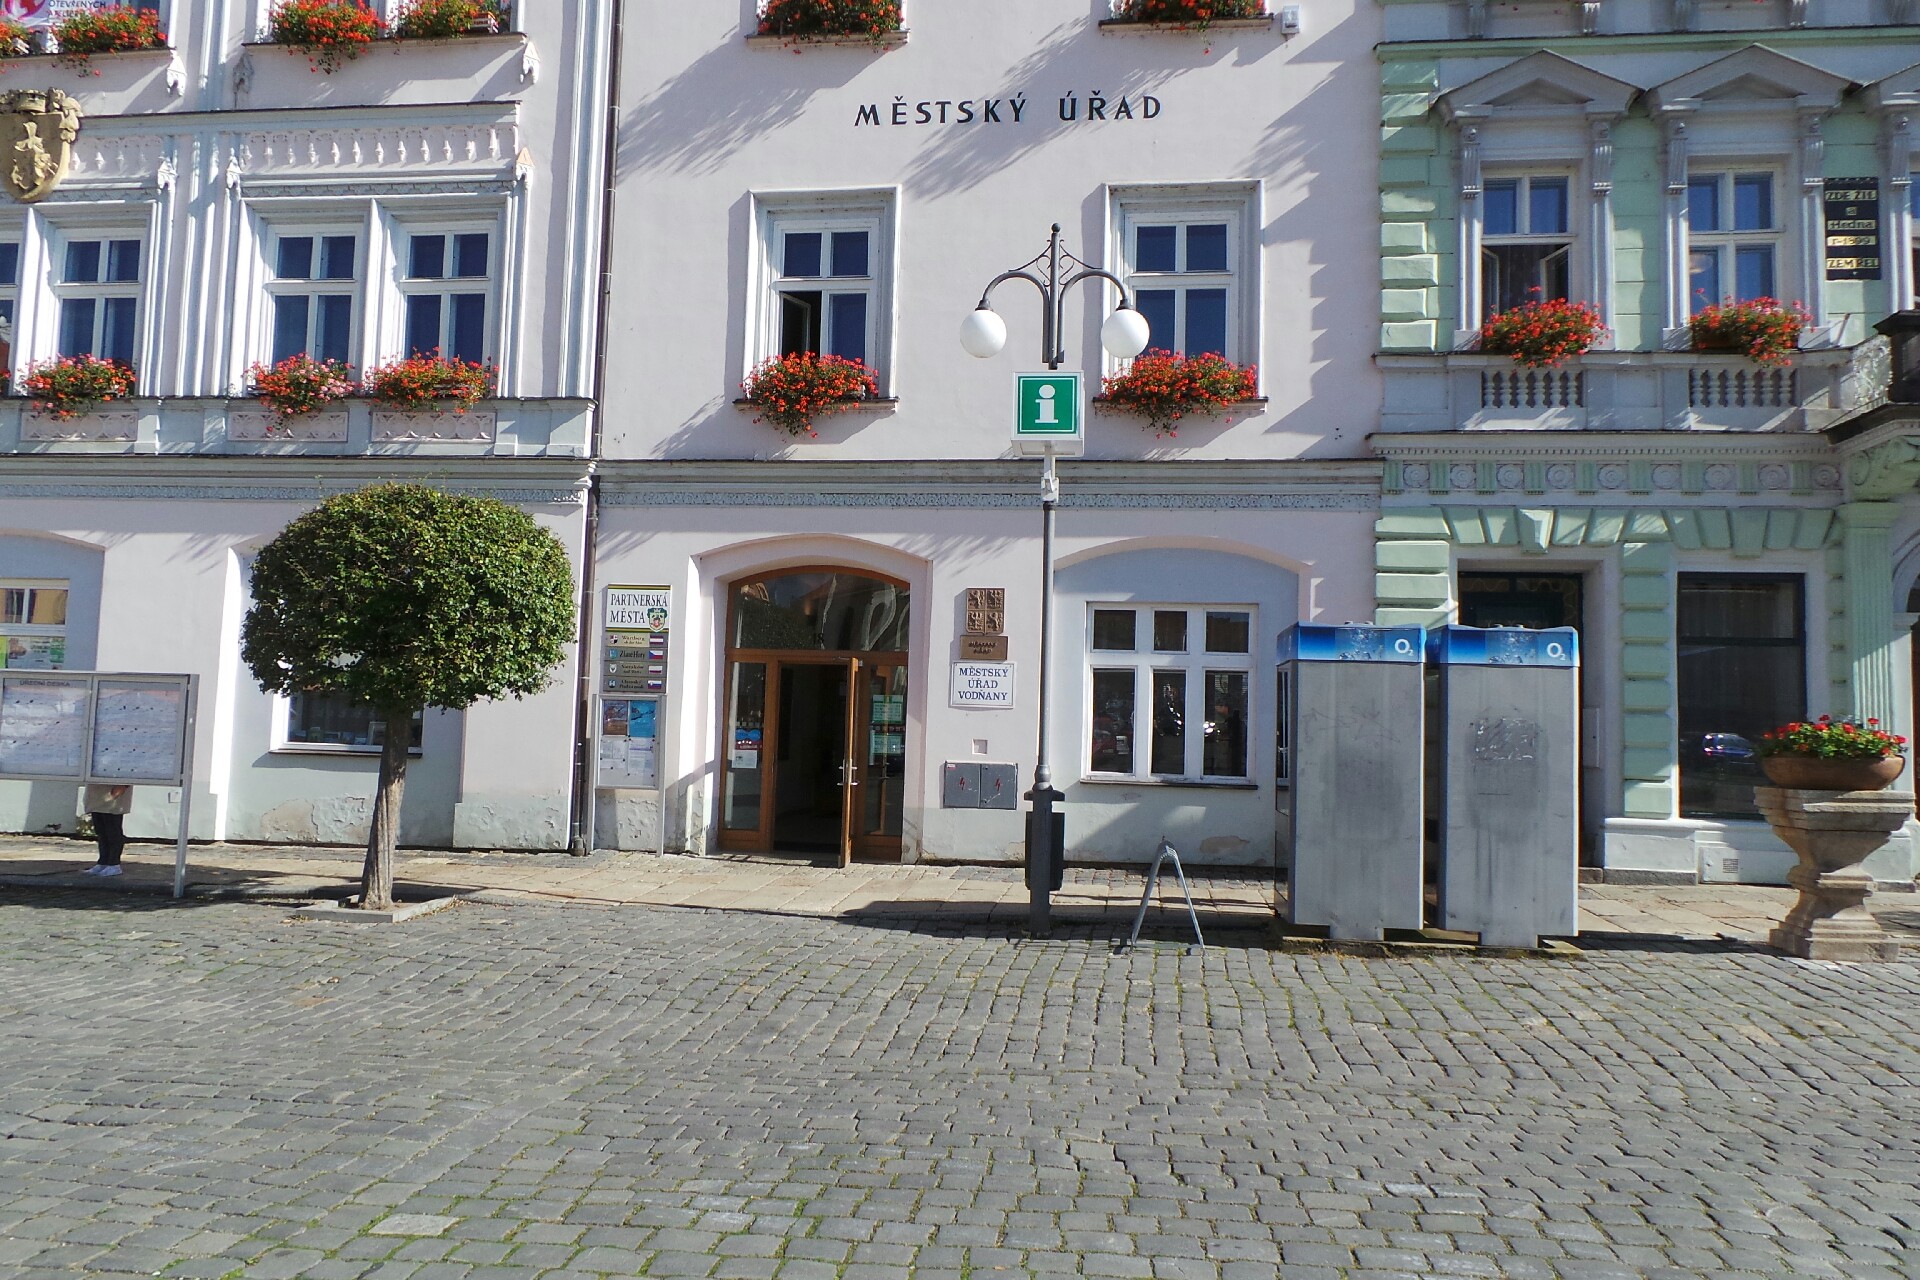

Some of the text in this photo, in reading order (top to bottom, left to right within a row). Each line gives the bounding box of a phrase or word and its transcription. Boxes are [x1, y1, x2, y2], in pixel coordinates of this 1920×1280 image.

[854, 90, 1161, 126] MĚSTSKÝ ÚŘAD
[610, 592, 668, 607] PARTNERSKÁ
[610, 607, 646, 624] MĚSTA
[959, 666, 1009, 677] MĚSTSKÝ
[968, 677, 998, 689] ÚŘAD
[958, 689, 1008, 701] VODŇANY
